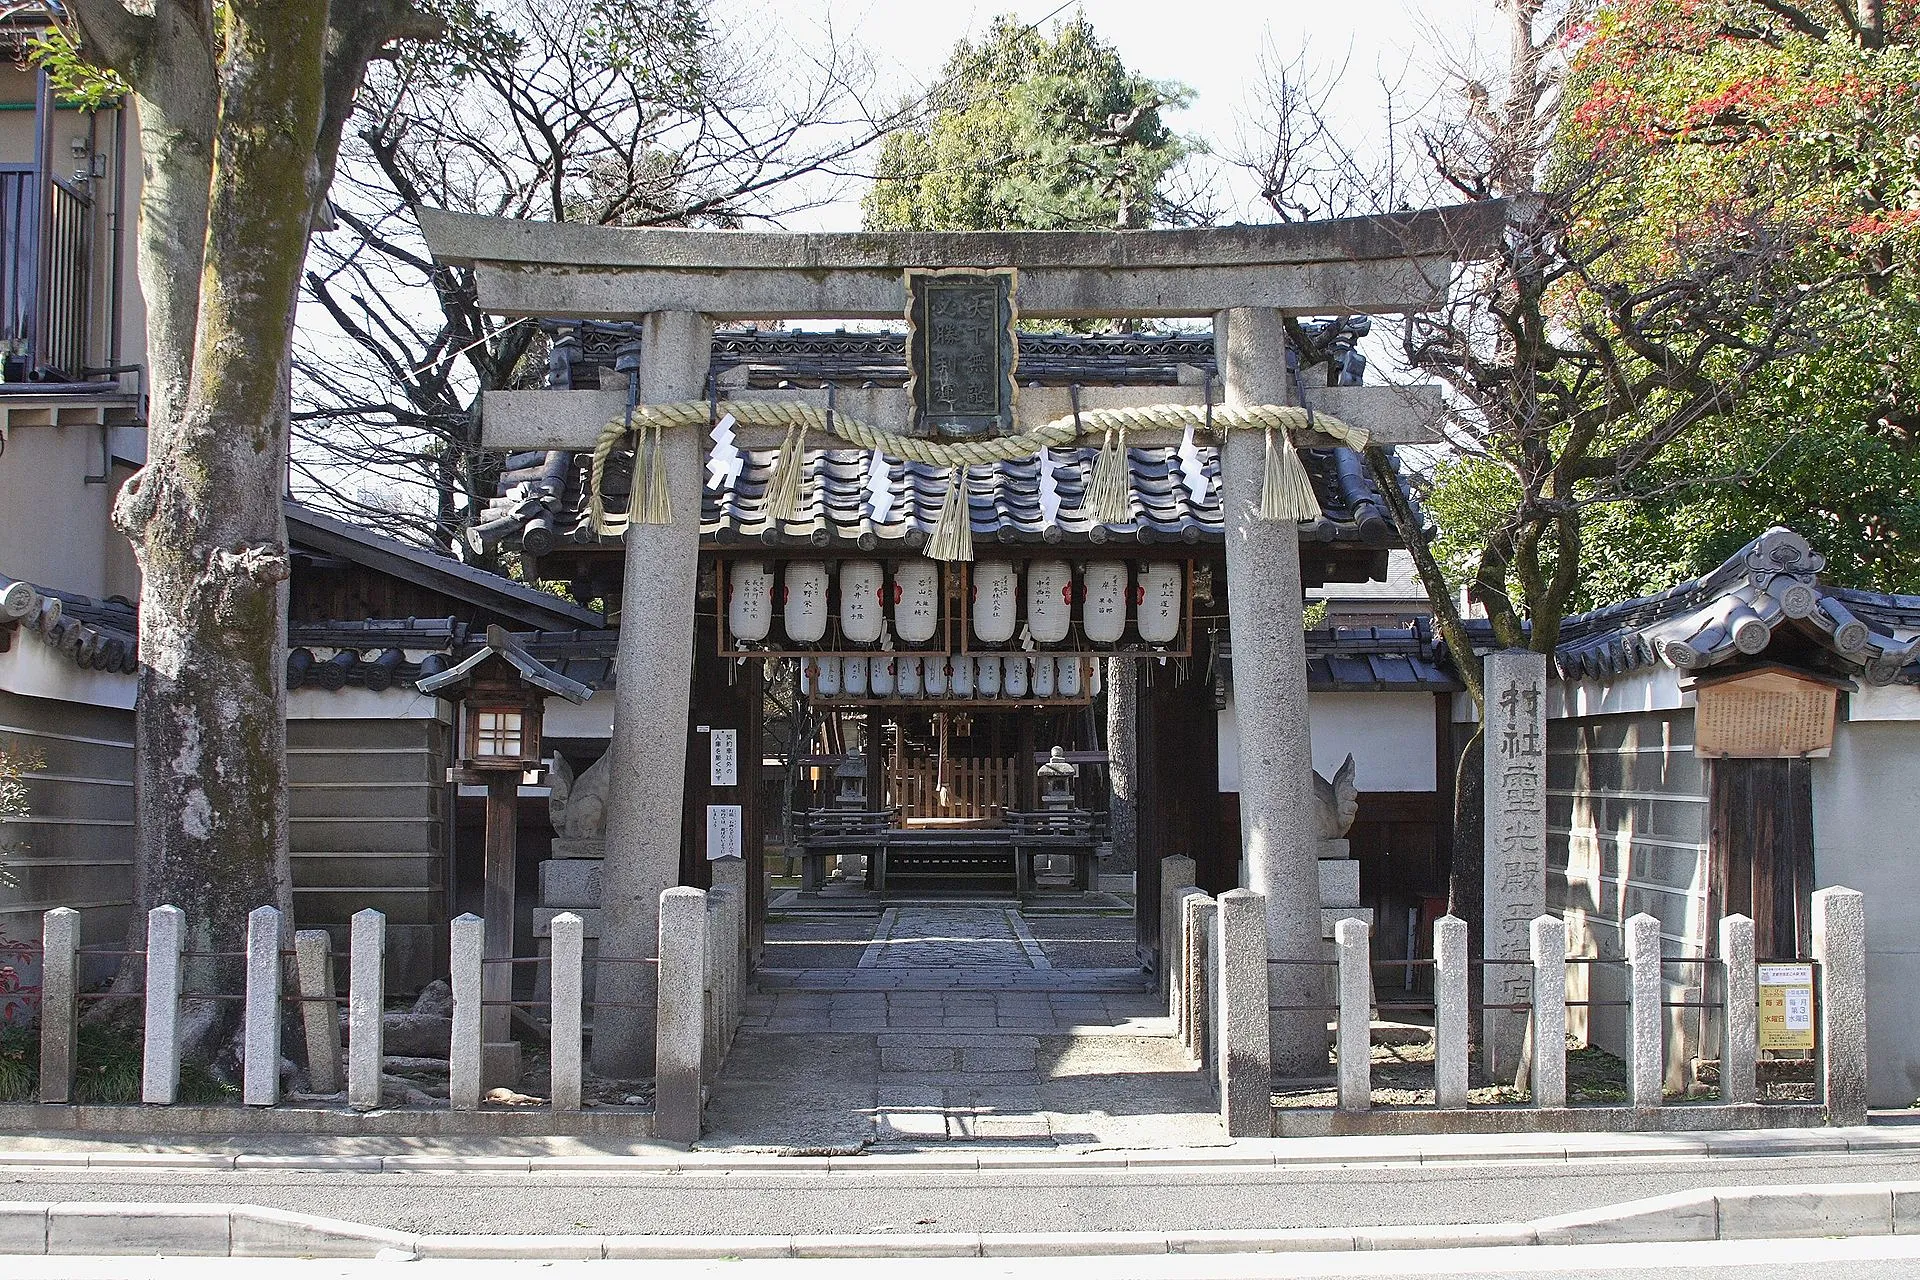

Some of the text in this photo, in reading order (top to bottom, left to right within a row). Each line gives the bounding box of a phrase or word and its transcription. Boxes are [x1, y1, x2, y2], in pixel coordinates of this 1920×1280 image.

[967, 293, 992, 403] 天下無敵
[854, 583, 863, 599] 今井
